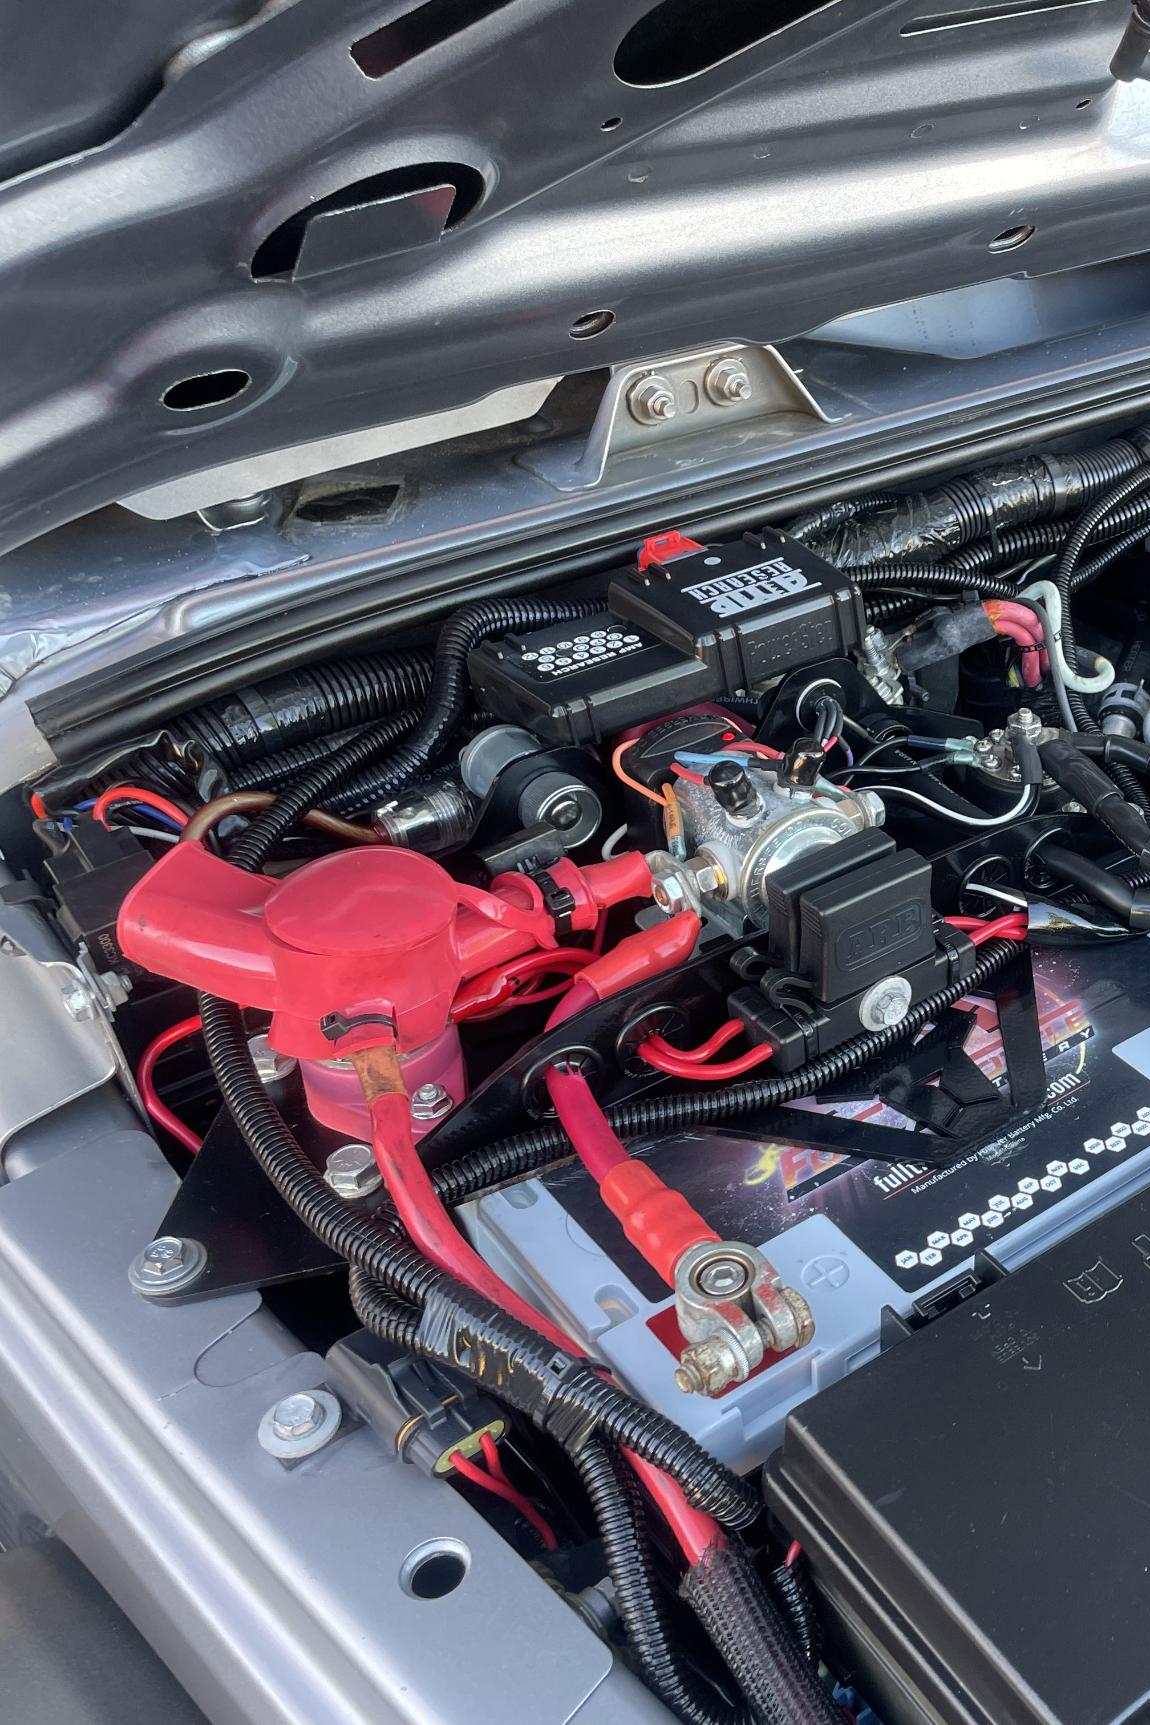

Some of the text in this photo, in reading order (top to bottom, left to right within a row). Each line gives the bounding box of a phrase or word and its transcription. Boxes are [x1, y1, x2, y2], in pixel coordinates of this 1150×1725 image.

[687, 561, 793, 600] RESEARCH
[551, 642, 643, 676] AMP RESEARCH
[911, 1159, 967, 1195] Manufactured
[966, 1152, 980, 1165] by
[1007, 1120, 1036, 1139] Battery
[1034, 1111, 1053, 1124] Mfg.
[1050, 1103, 1065, 1114] Co.
[1063, 1096, 1080, 1107] Ltd.
